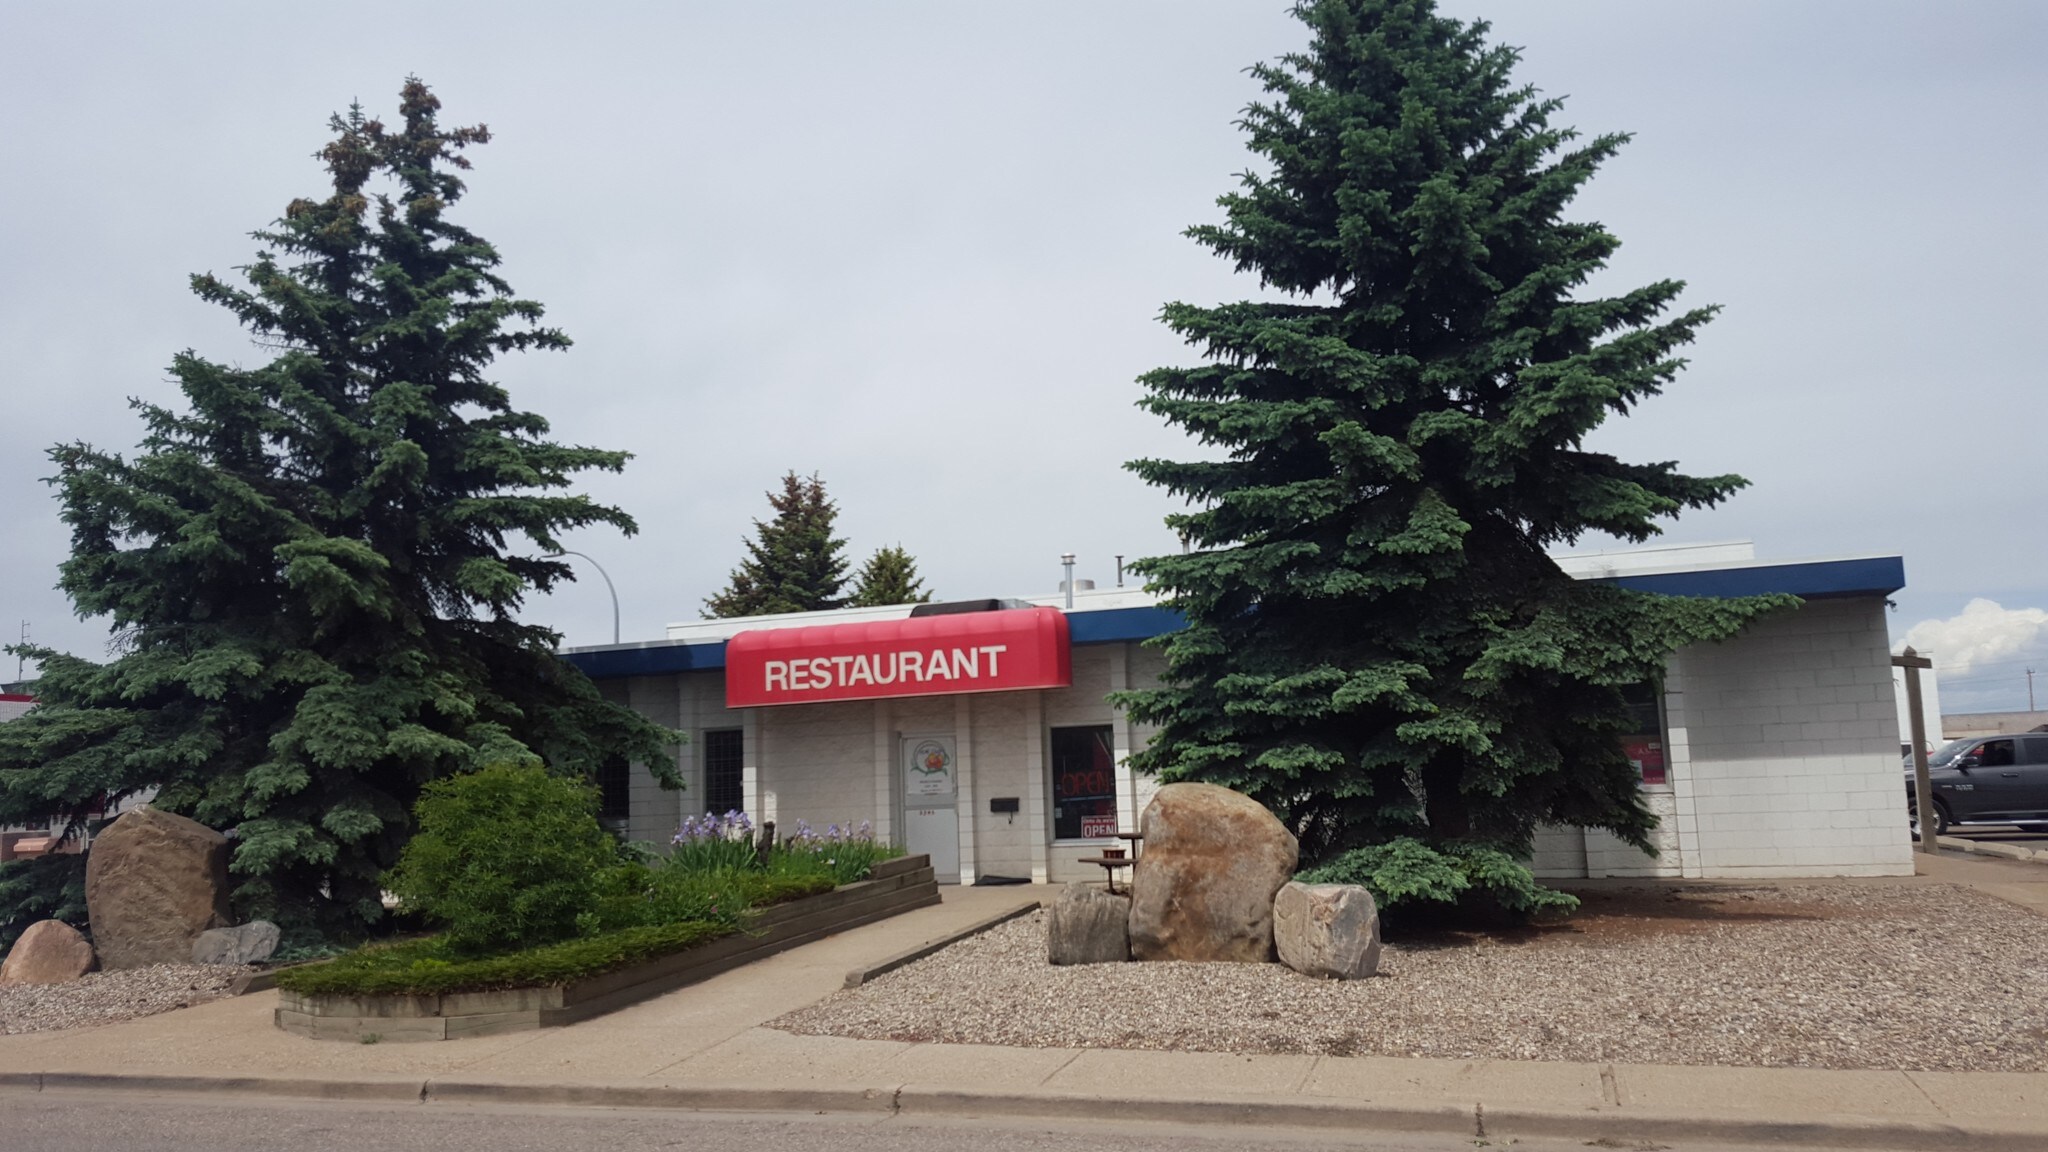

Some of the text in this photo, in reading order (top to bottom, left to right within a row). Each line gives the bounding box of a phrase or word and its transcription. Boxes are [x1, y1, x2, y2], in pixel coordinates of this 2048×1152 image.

[765, 645, 1007, 691] RESTAURANT
[1062, 769, 1110, 796] OPEN
[1084, 825, 1114, 837] OPEN
